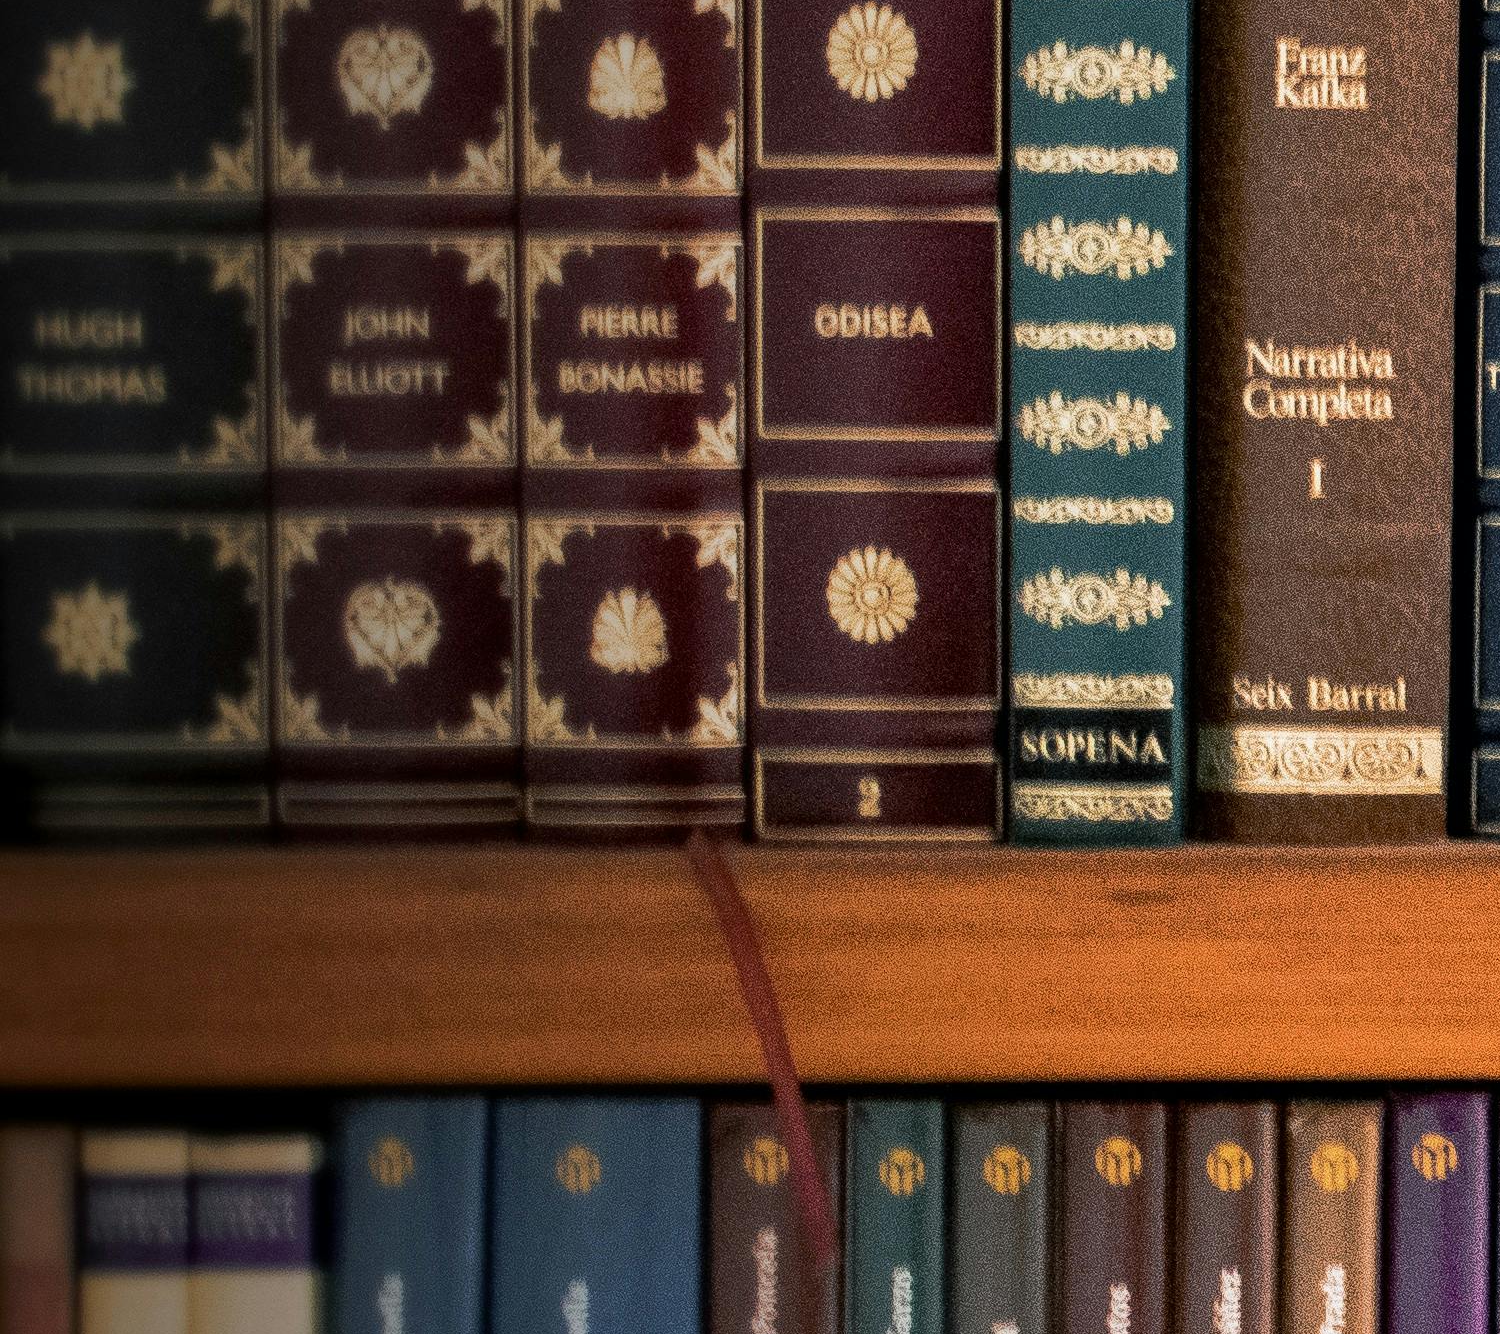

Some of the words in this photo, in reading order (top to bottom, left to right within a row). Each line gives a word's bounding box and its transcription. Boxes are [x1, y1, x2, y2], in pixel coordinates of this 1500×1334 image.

[1276, 38, 1366, 78] Franz
[1276, 76, 1367, 109] Kafka
[814, 304, 932, 339] ODISEA
[1246, 340, 1396, 379] Narrativa
[1243, 382, 1393, 426] Completa
[1311, 459, 1323, 498] I
[1234, 676, 1293, 710] Seix
[1308, 676, 1406, 711] Barral
[1022, 730, 1167, 763] SOPENA
